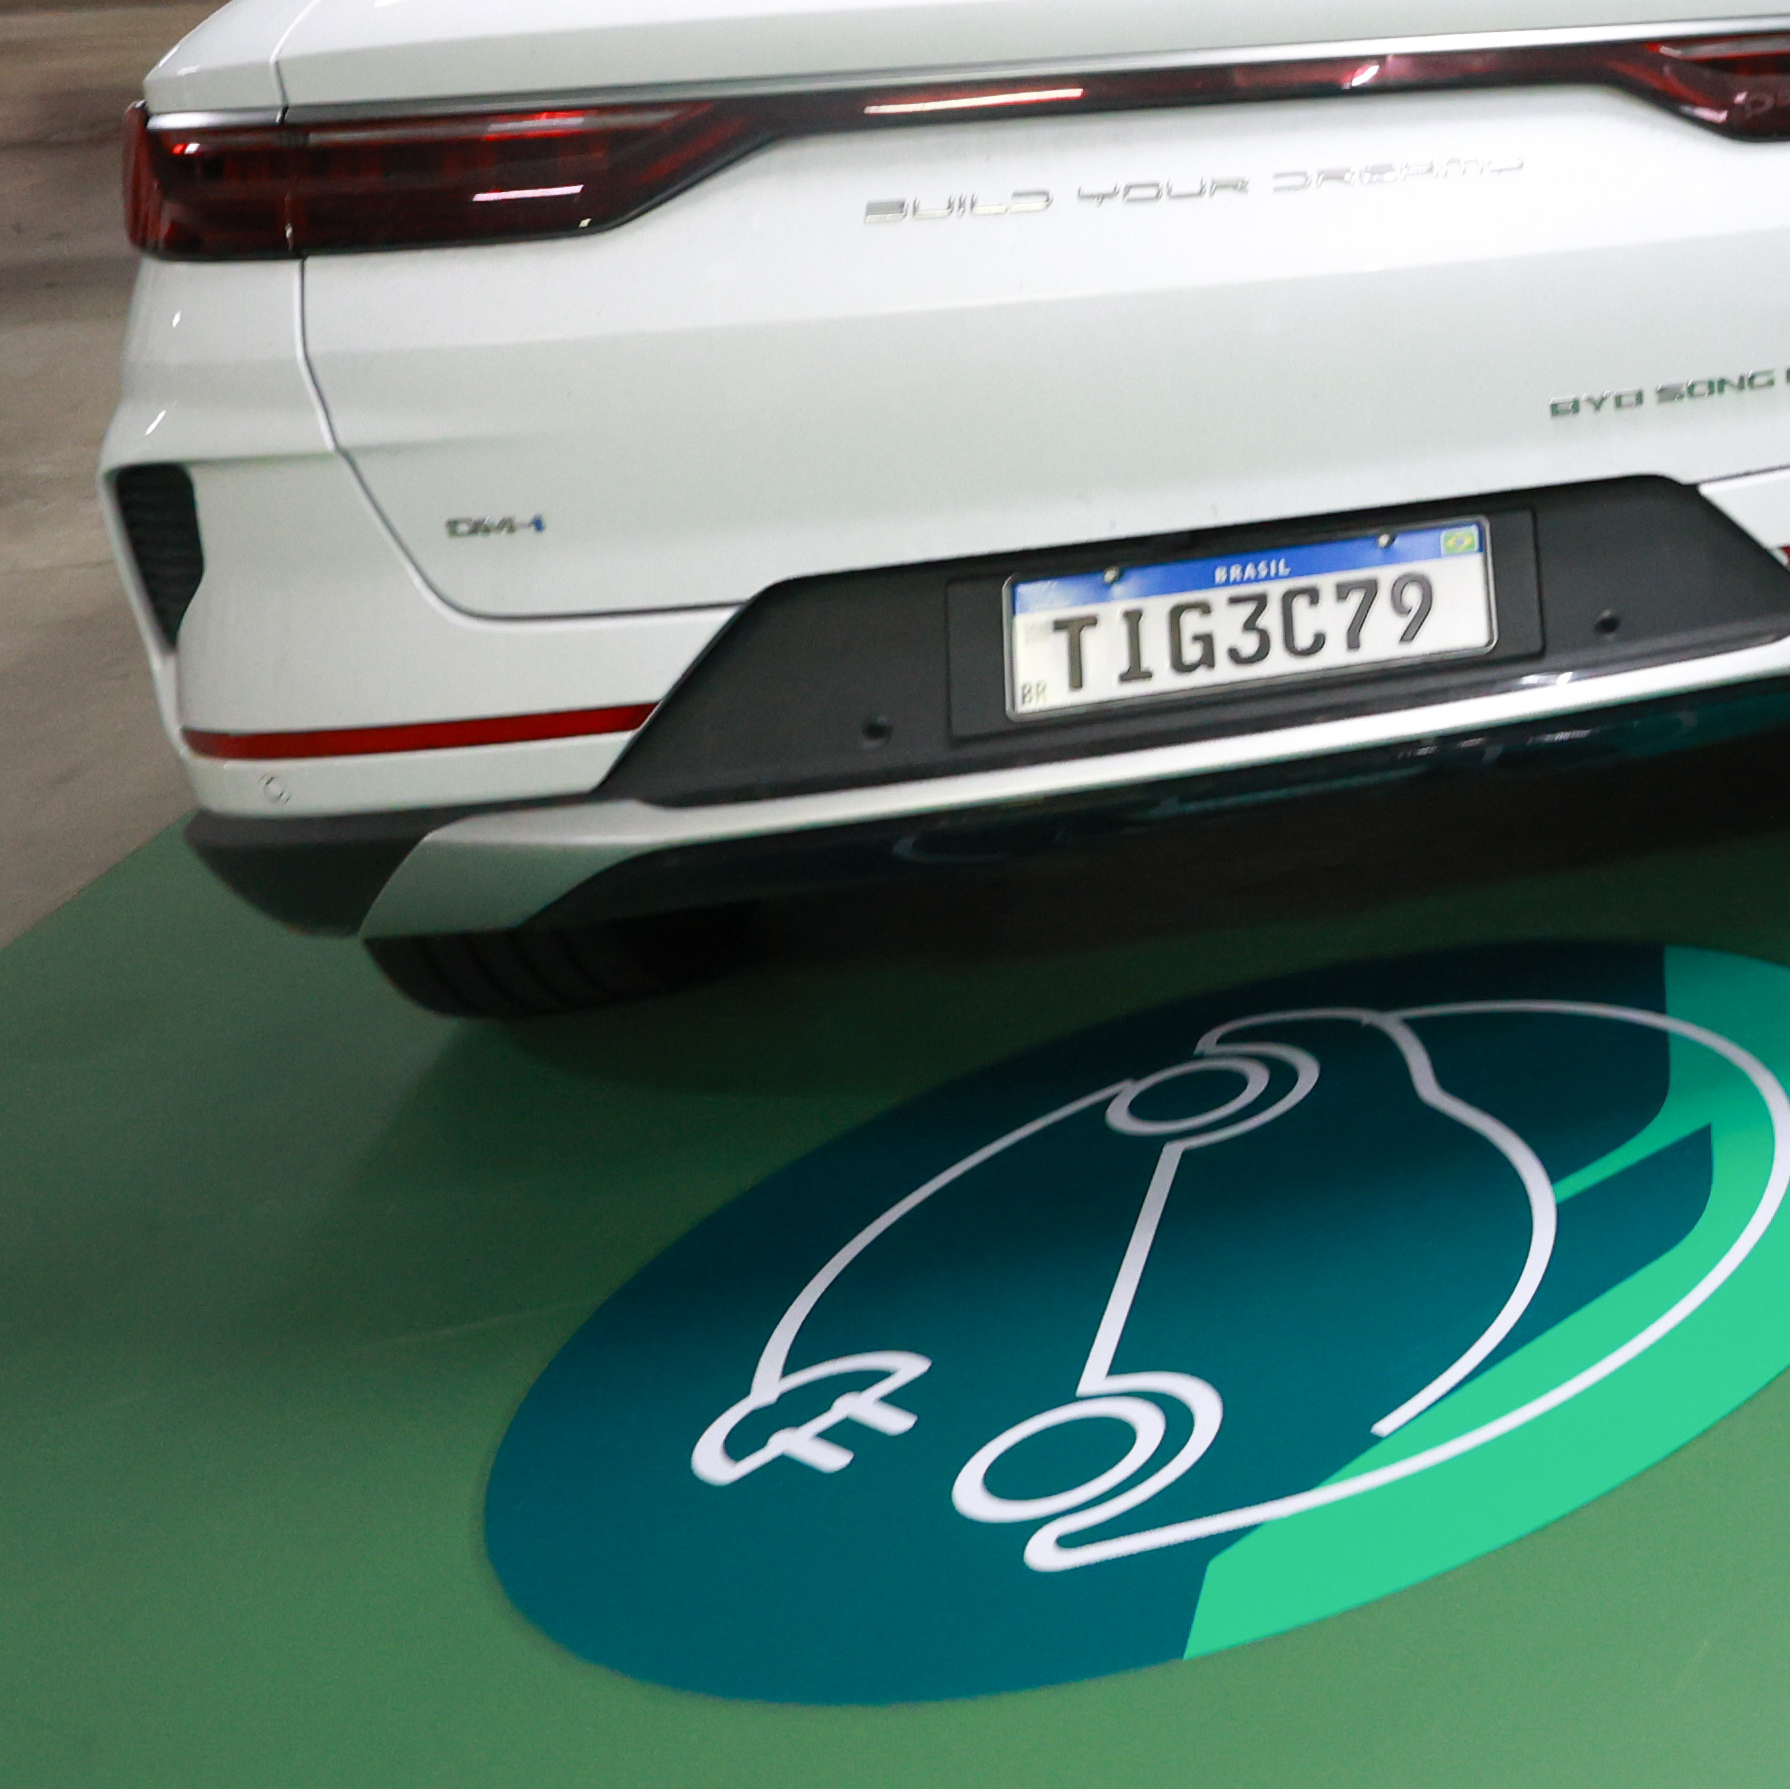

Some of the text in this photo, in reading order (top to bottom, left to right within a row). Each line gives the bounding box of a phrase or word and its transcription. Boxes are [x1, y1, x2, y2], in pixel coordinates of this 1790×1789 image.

[864, 189, 1053, 223] BUILD
[1078, 177, 1249, 208] YOUR
[1655, 369, 1775, 403] SONG
[1214, 557, 1292, 584] BRASIL
[1053, 571, 1435, 692] TIG3C79
